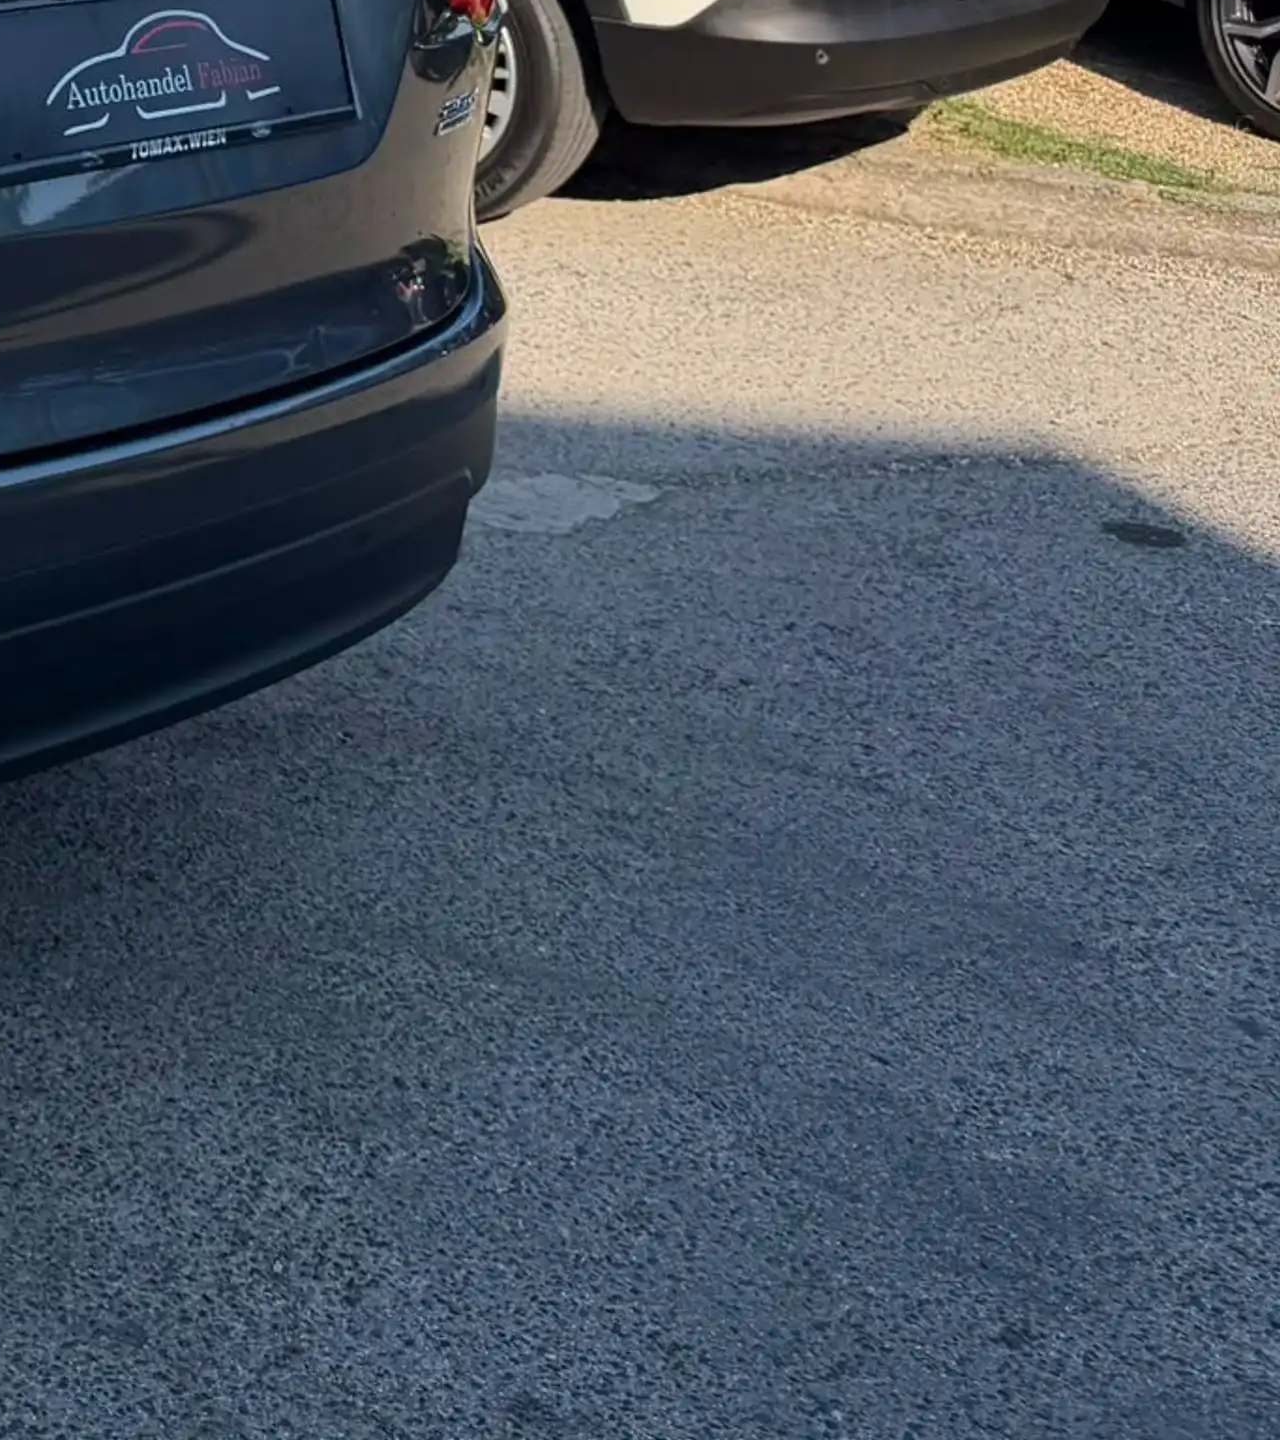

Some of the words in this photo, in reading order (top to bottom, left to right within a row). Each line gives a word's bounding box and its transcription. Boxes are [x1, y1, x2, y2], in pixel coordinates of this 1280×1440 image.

[66, 65, 193, 110] Autohandel
[197, 59, 262, 90] Fabian
[130, 128, 227, 160] TOMAX.WIEN
